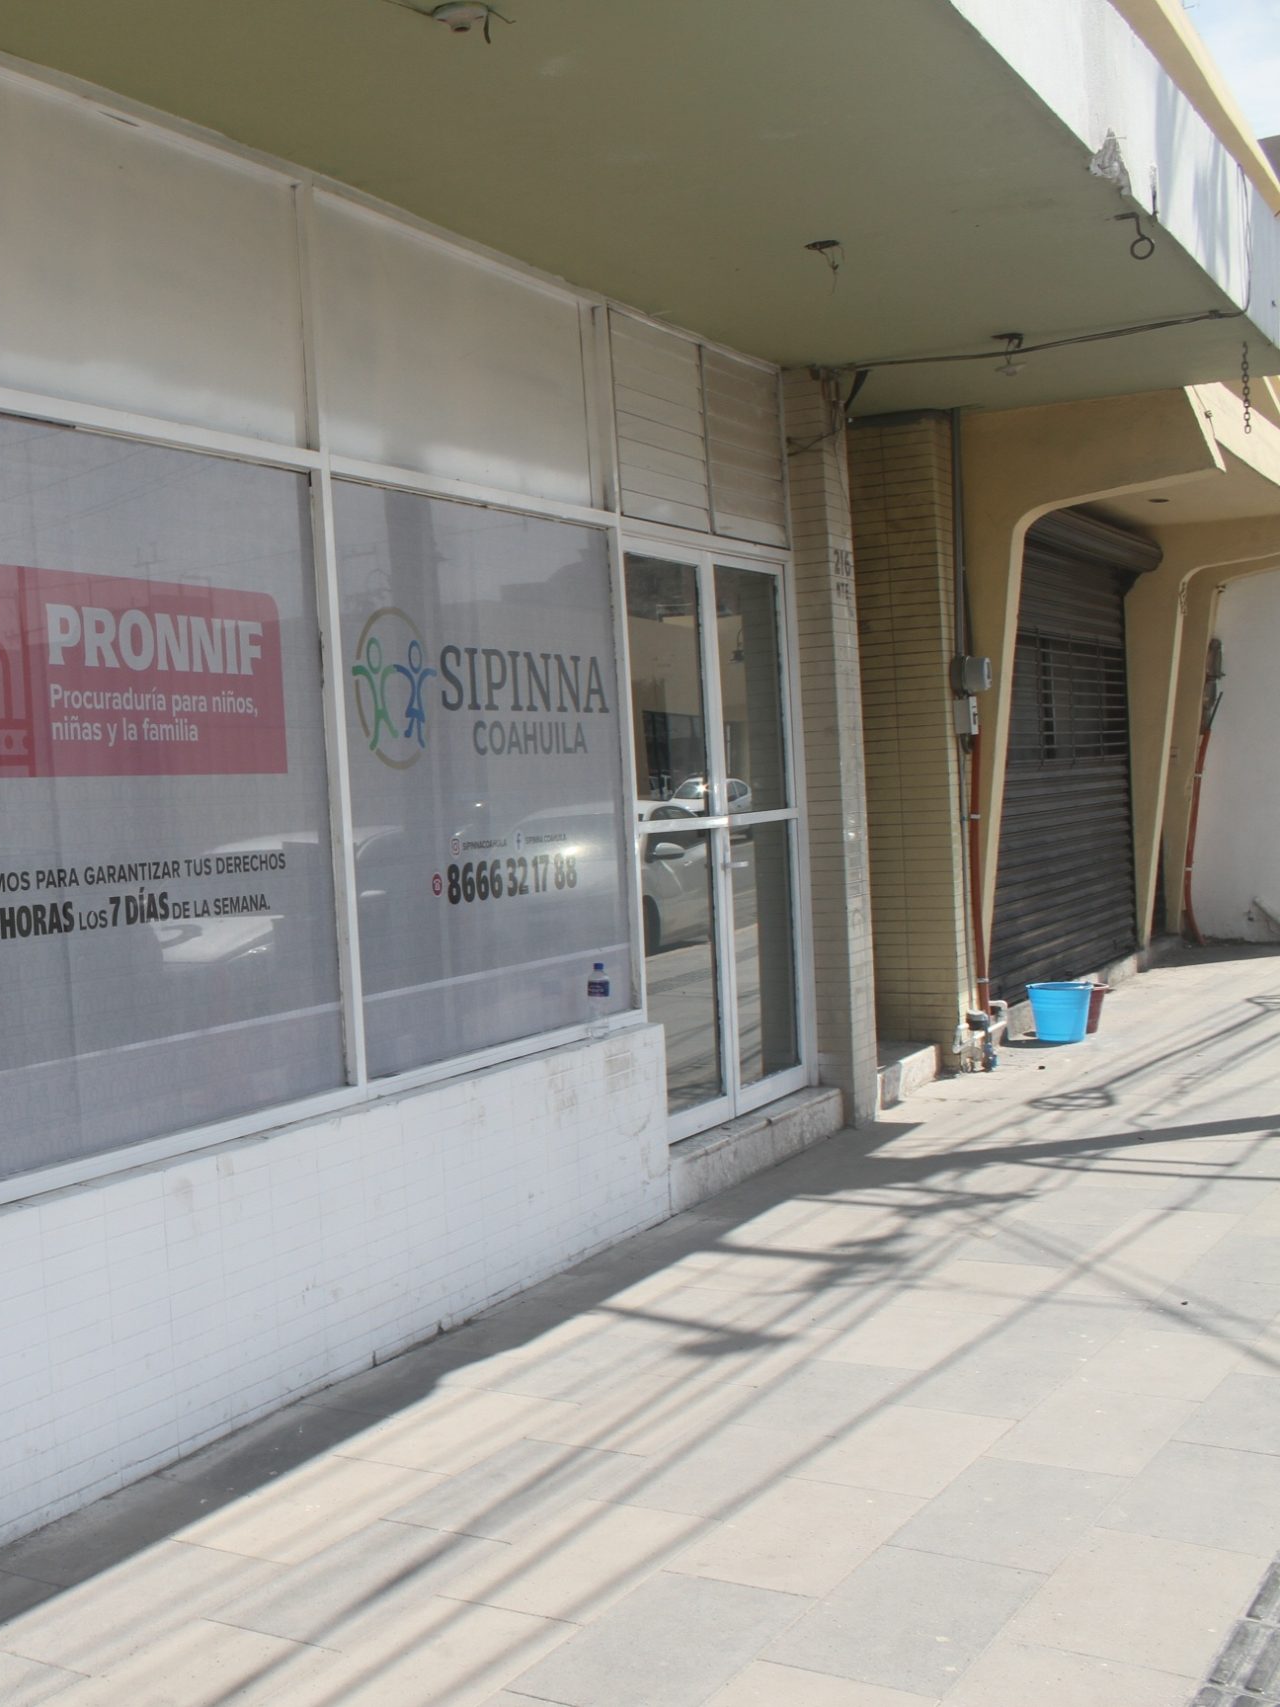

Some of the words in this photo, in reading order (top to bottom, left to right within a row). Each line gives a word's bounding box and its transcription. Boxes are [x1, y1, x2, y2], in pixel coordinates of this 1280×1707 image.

[834, 549, 851, 576] 216
[45, 603, 263, 675] PRONNIF
[440, 645, 610, 713] SIPINNA
[50, 683, 167, 711] Procuraduría
[172, 692, 209, 721] para
[211, 689, 259, 717] niños,
[52, 714, 102, 741] niñas
[108, 722, 118, 747] y
[123, 717, 138, 741] la
[142, 716, 199, 742] familia
[473, 720, 588, 755] COAHUILA
[36, 867, 80, 890] PARA
[84, 860, 181, 886] GARANTIZAR
[184, 858, 213, 876] TUS
[216, 853, 287, 874] DERECHOS
[447, 859, 503, 904] 8666
[0, 901, 75, 940] HORAS
[79, 909, 109, 931] LOS
[109, 896, 122, 927] 7
[125, 887, 170, 925] DÍAS
[172, 901, 191, 919] DE
[193, 899, 210, 917] LA
[213, 894, 271, 916] SEMANA.
